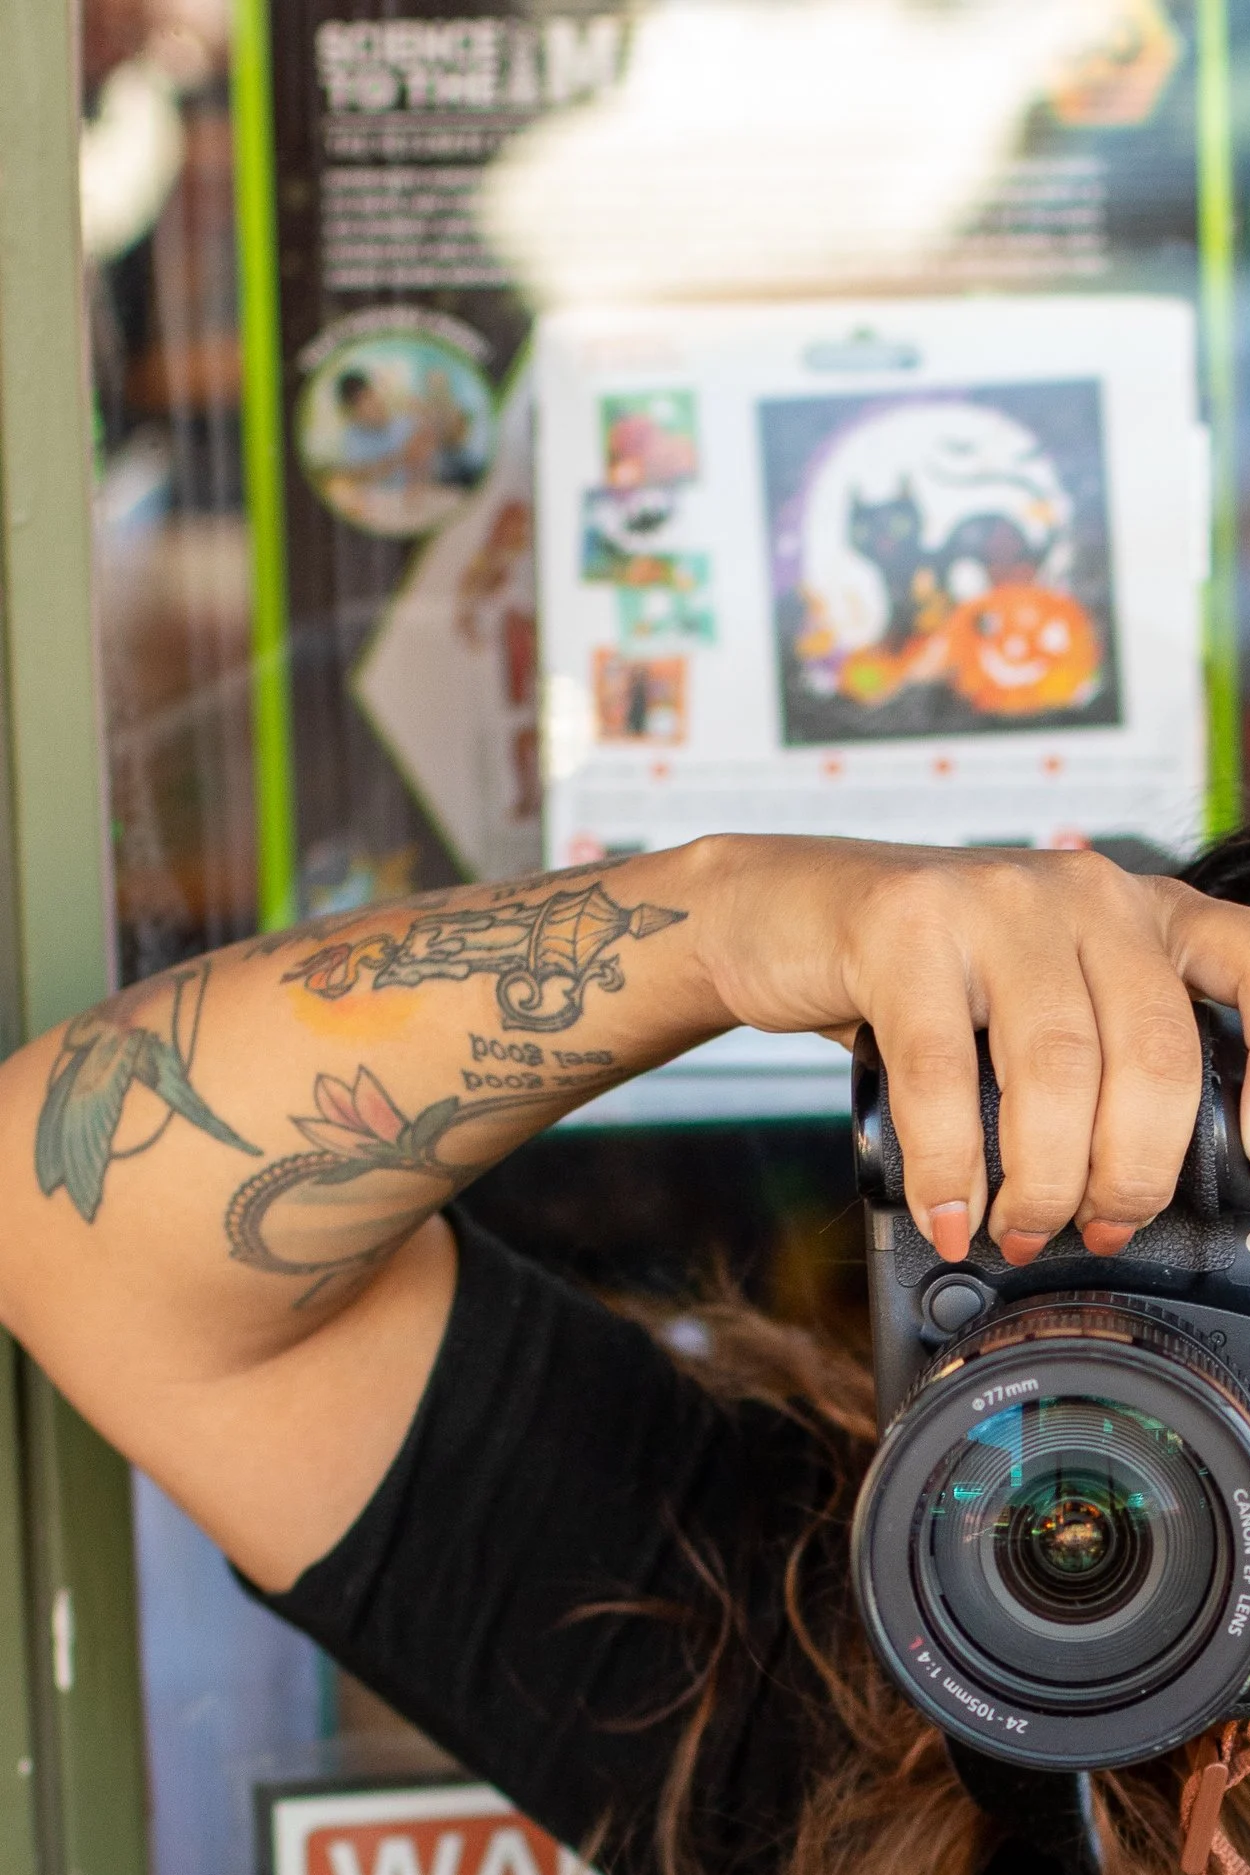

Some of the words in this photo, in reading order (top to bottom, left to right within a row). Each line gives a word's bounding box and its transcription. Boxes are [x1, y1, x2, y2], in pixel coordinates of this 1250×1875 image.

[468, 1032, 545, 1067] good
[460, 1067, 544, 1092] good
[917, 1651, 942, 1679] 1:4
[942, 1676, 1029, 1734] 24-105mm
